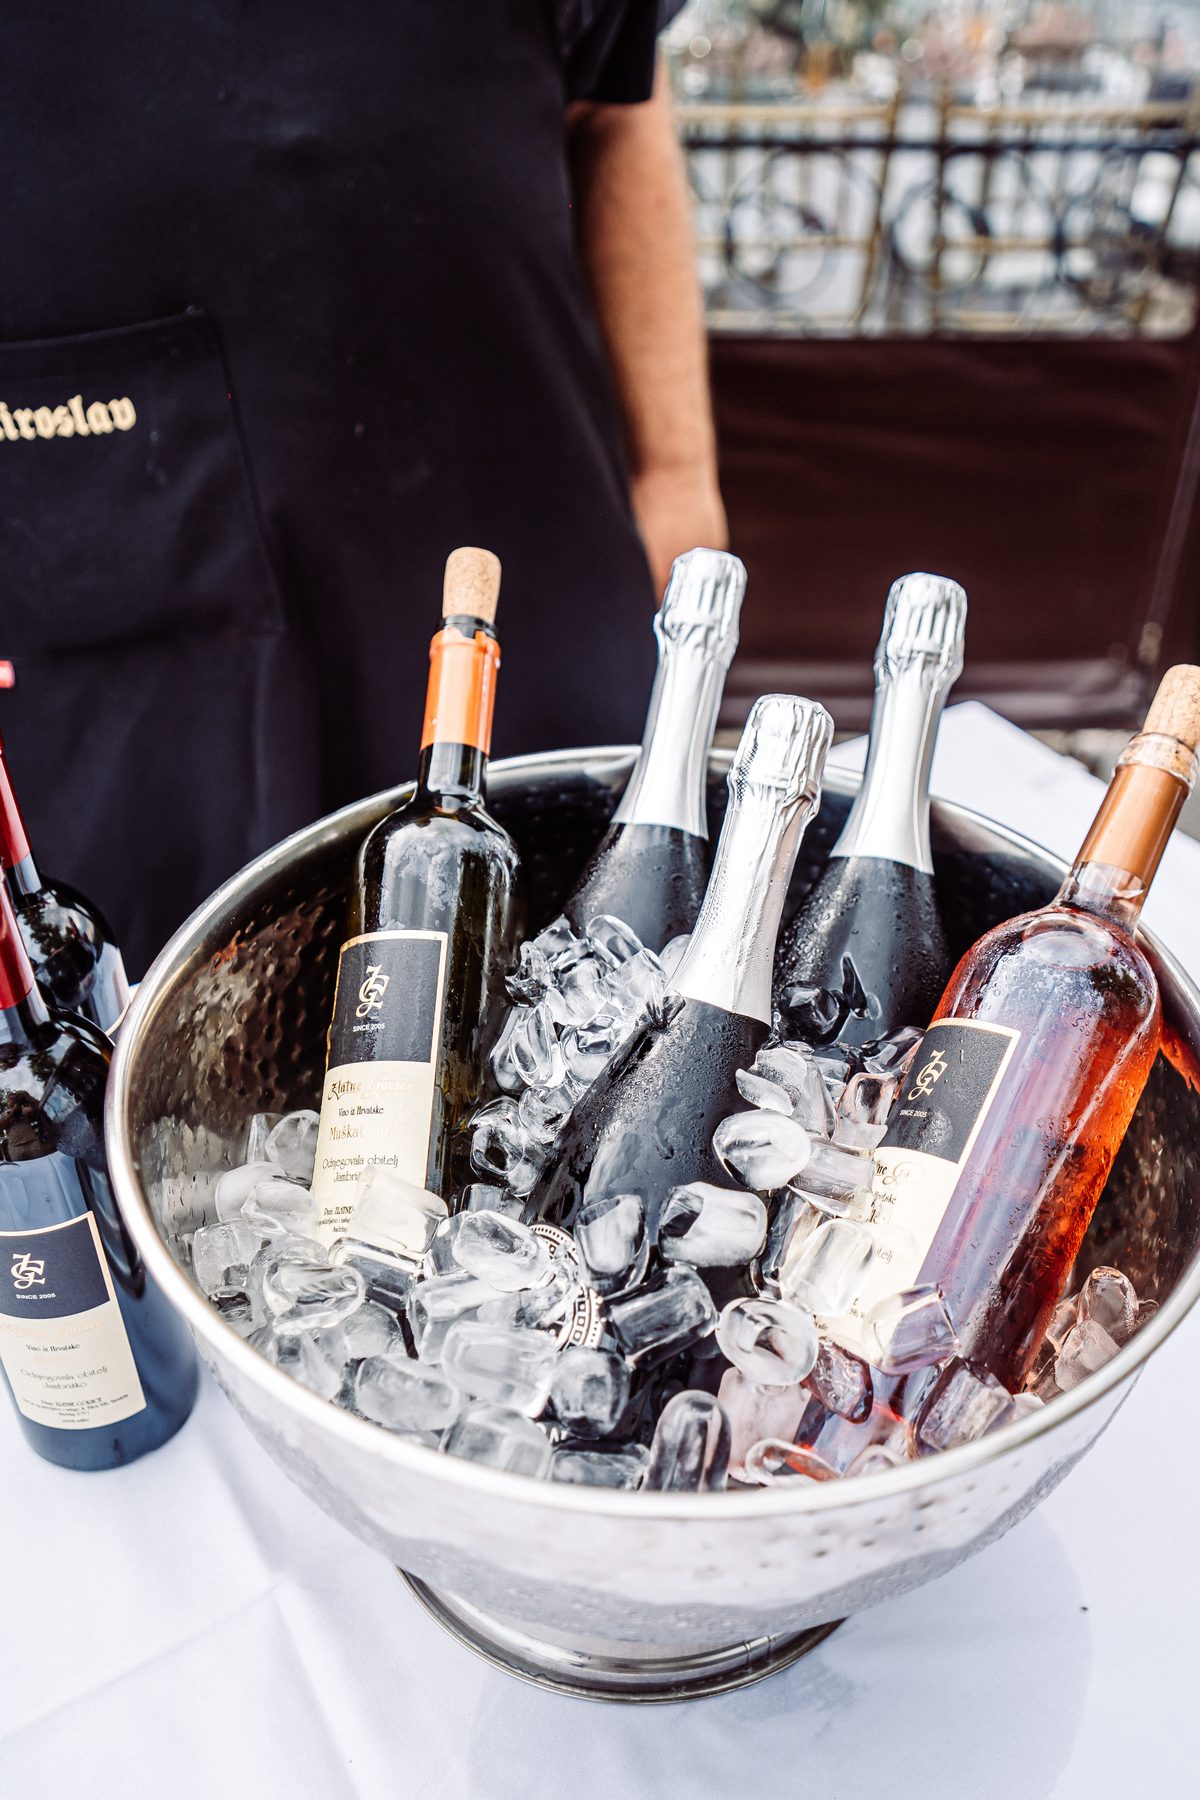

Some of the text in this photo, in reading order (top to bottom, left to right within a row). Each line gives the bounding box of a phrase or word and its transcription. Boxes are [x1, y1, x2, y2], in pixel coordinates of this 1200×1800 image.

[0, 394, 137, 441] iroslav
[352, 1023, 386, 1033] SINCE 2005
[338, 1107, 349, 1117] Vino
[356, 1104, 385, 1116] Hrvatske
[914, 1110, 928, 1118] 2005
[322, 1153, 399, 1171] Odnjegovala obitelj
[39, 1292, 56, 1300] 2005
[25, 1344, 41, 1352] Vino
[50, 1343, 80, 1353] Hrvatske
[20, 1365, 108, 1383] Odnjegovala obitelj
